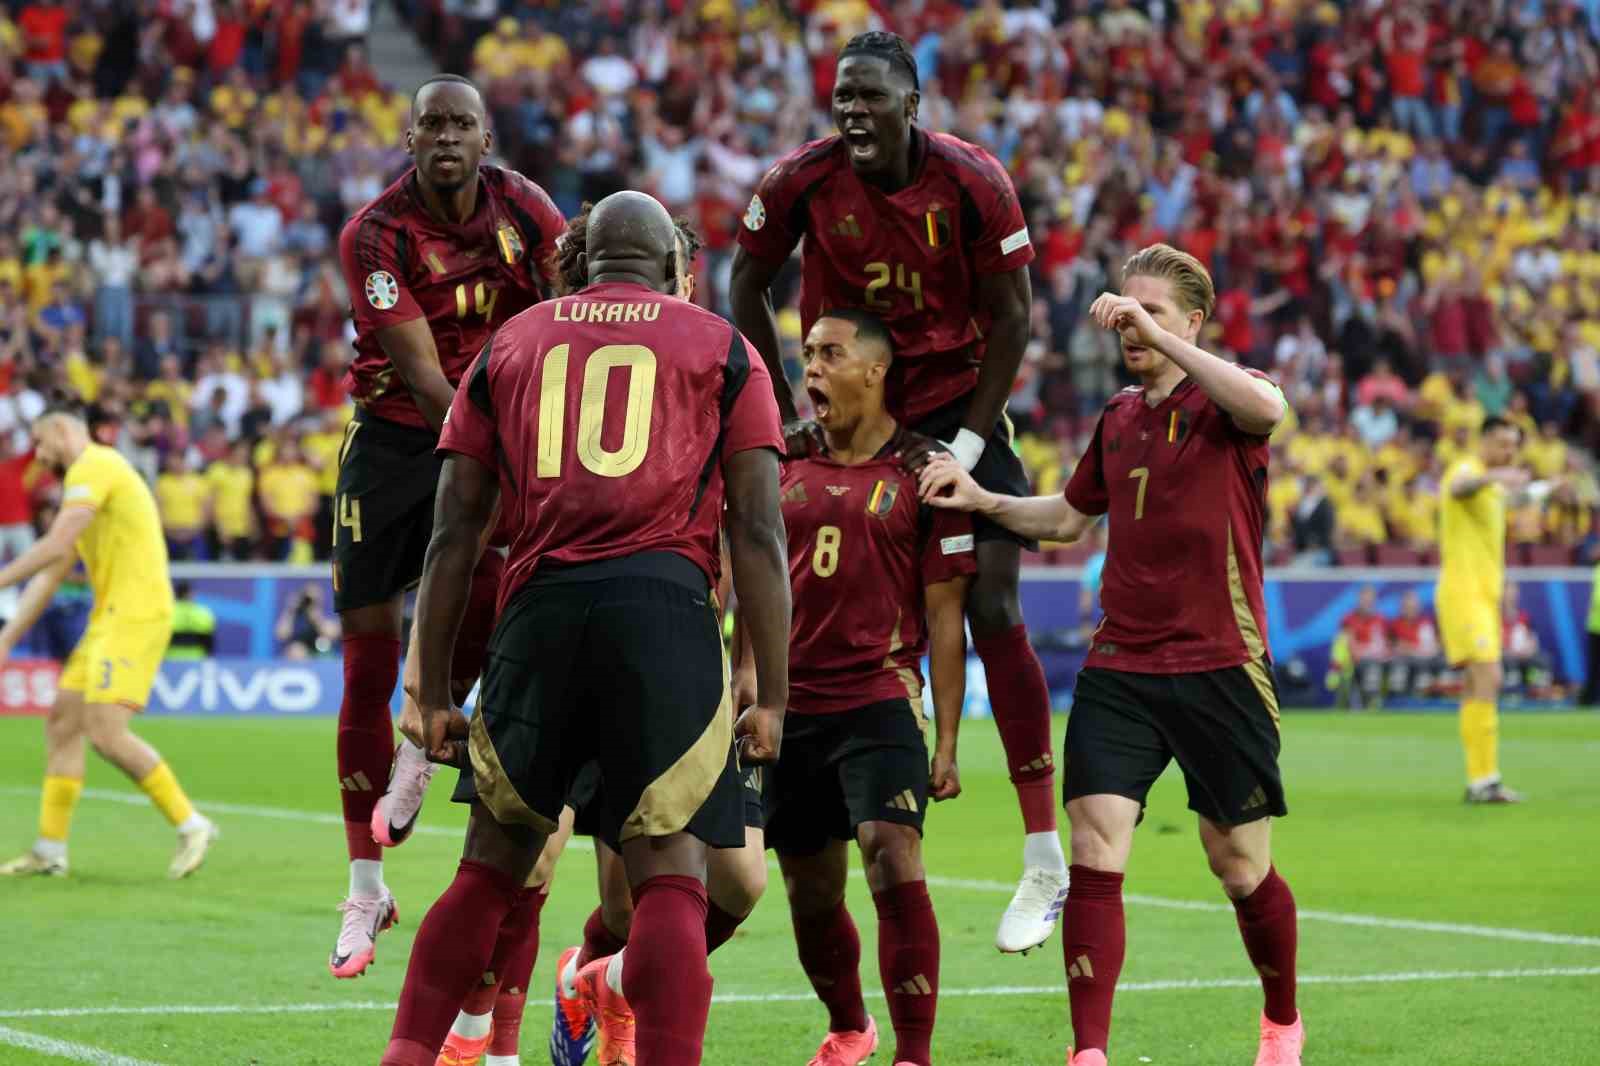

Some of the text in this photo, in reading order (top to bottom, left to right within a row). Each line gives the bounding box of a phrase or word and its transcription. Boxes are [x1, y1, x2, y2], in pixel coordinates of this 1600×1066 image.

[456, 282, 499, 321] 14
[864, 262, 924, 312] 24
[554, 303, 661, 322] LUKAKU
[537, 344, 656, 478] 10
[1128, 467, 1149, 520] 7
[812, 526, 842, 577] 8
[154, 661, 321, 711] vivo
